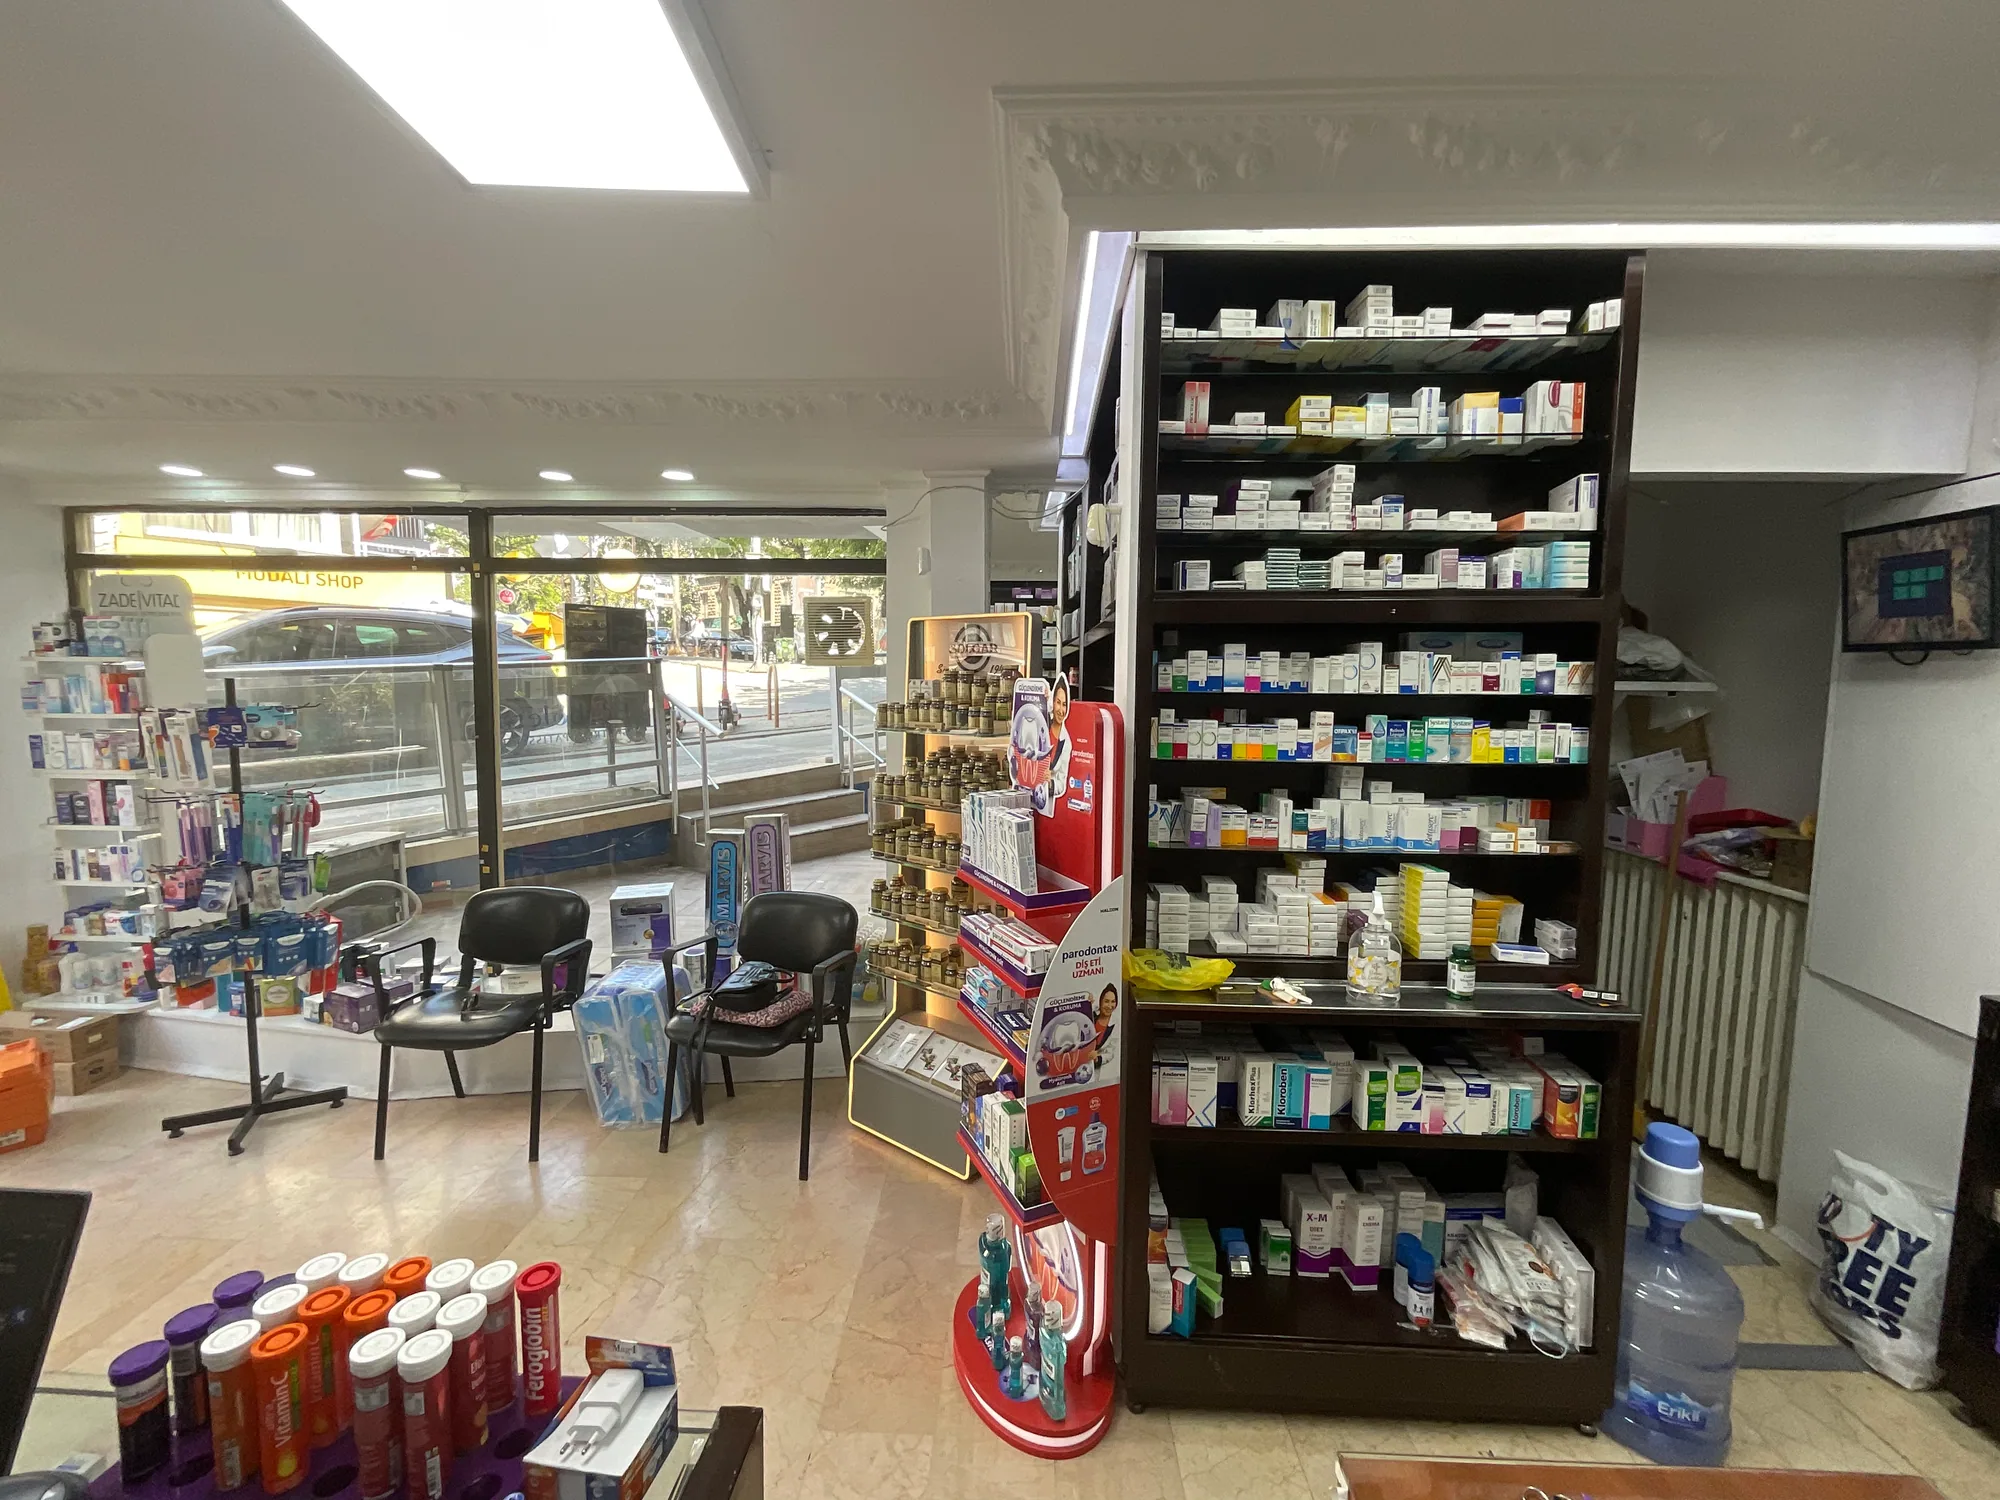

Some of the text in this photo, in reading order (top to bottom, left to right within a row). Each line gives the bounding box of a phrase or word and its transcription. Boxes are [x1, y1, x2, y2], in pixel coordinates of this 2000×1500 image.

[316, 573, 363, 589] SHOP
[717, 847, 732, 918] MARVIS
[1062, 945, 1118, 963] parodontax
[1072, 967, 1104, 978] UZMANI
[1277, 1068, 1288, 1116] Kloroben
[1512, 1093, 1521, 1127] Kloroben
[1306, 1213, 1328, 1222] X-M
[523, 1307, 549, 1401] Feroglobin
